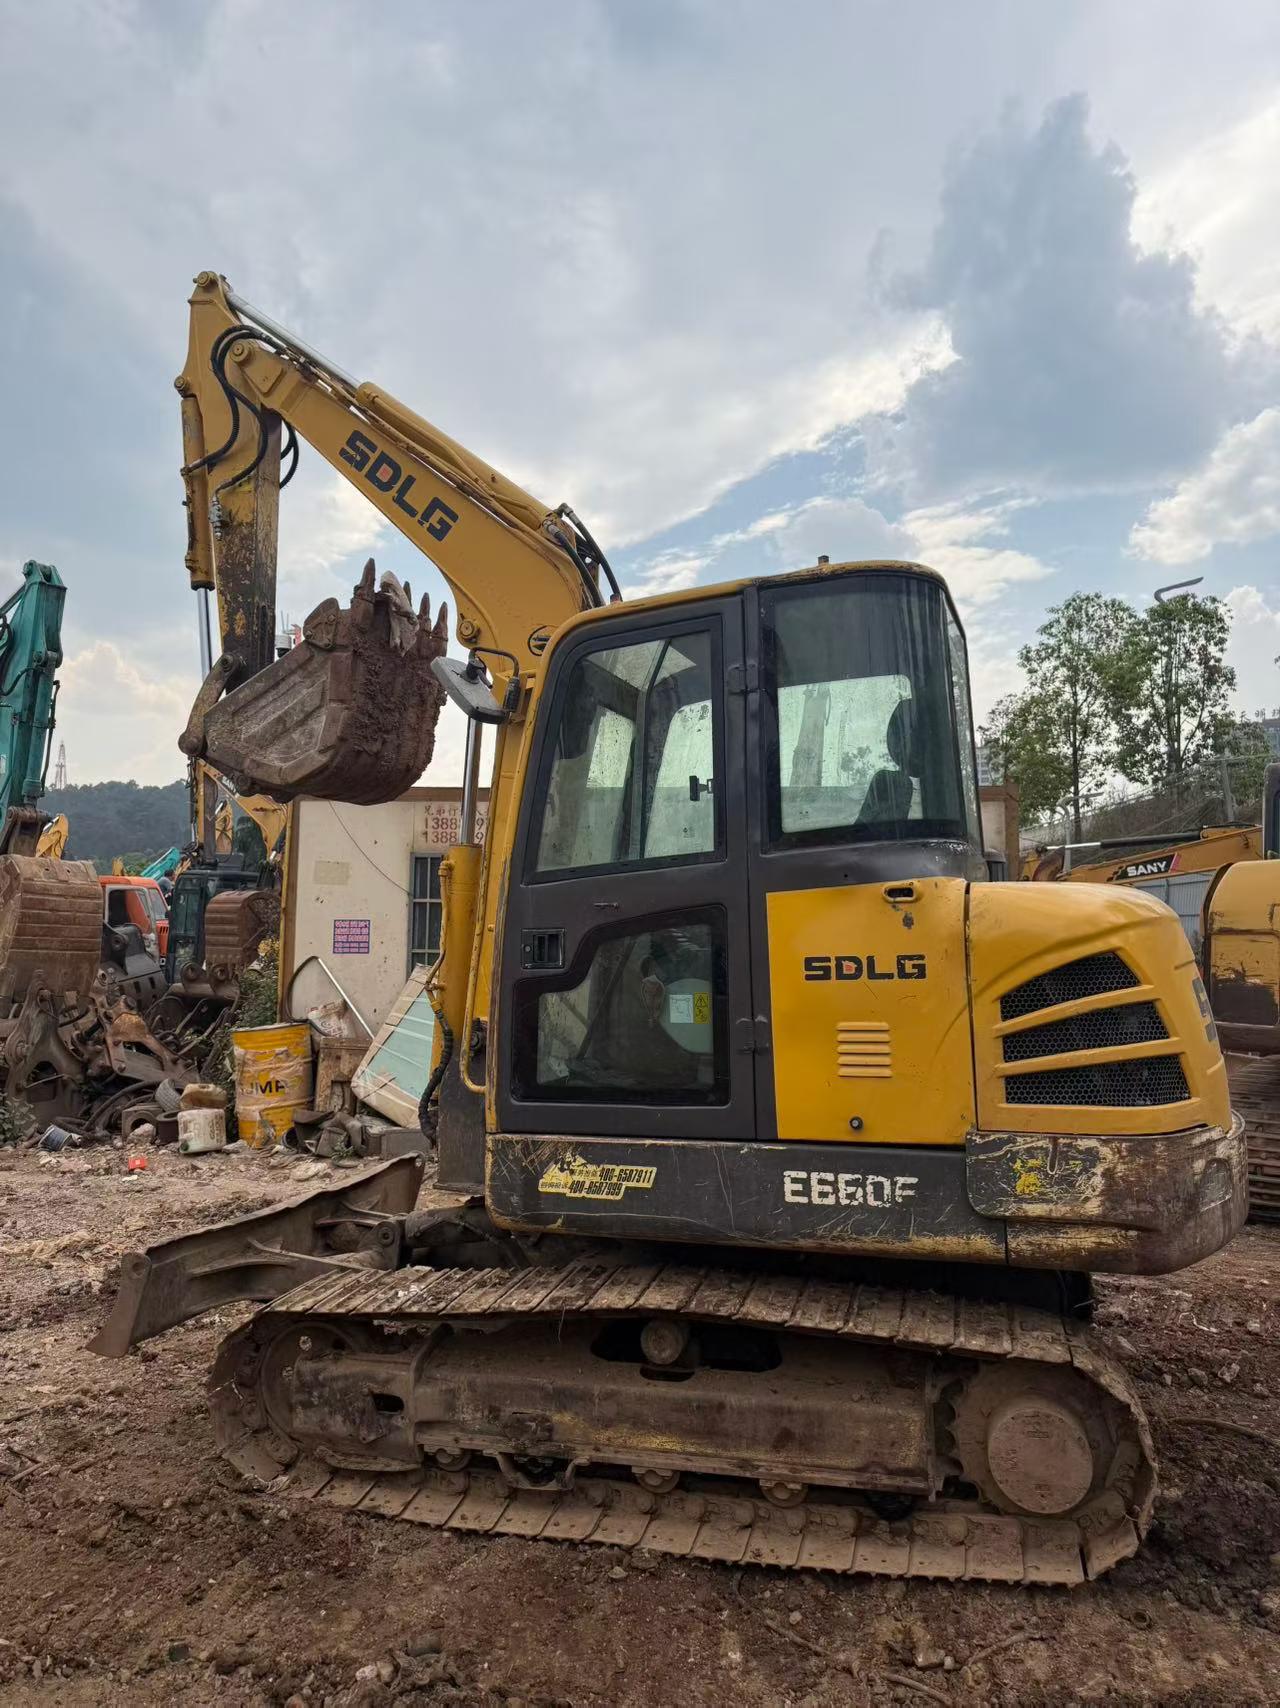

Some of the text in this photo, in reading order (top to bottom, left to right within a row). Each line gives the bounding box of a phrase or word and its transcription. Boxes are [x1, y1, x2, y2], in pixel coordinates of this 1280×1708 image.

[338, 430, 459, 542] SDLG
[1127, 861, 1167, 877] SANY
[804, 954, 926, 980] SDLG
[599, 1167, 653, 1184] 400-6587911
[568, 1180, 624, 1196] 400-6587999
[783, 1170, 919, 1207] E660F
